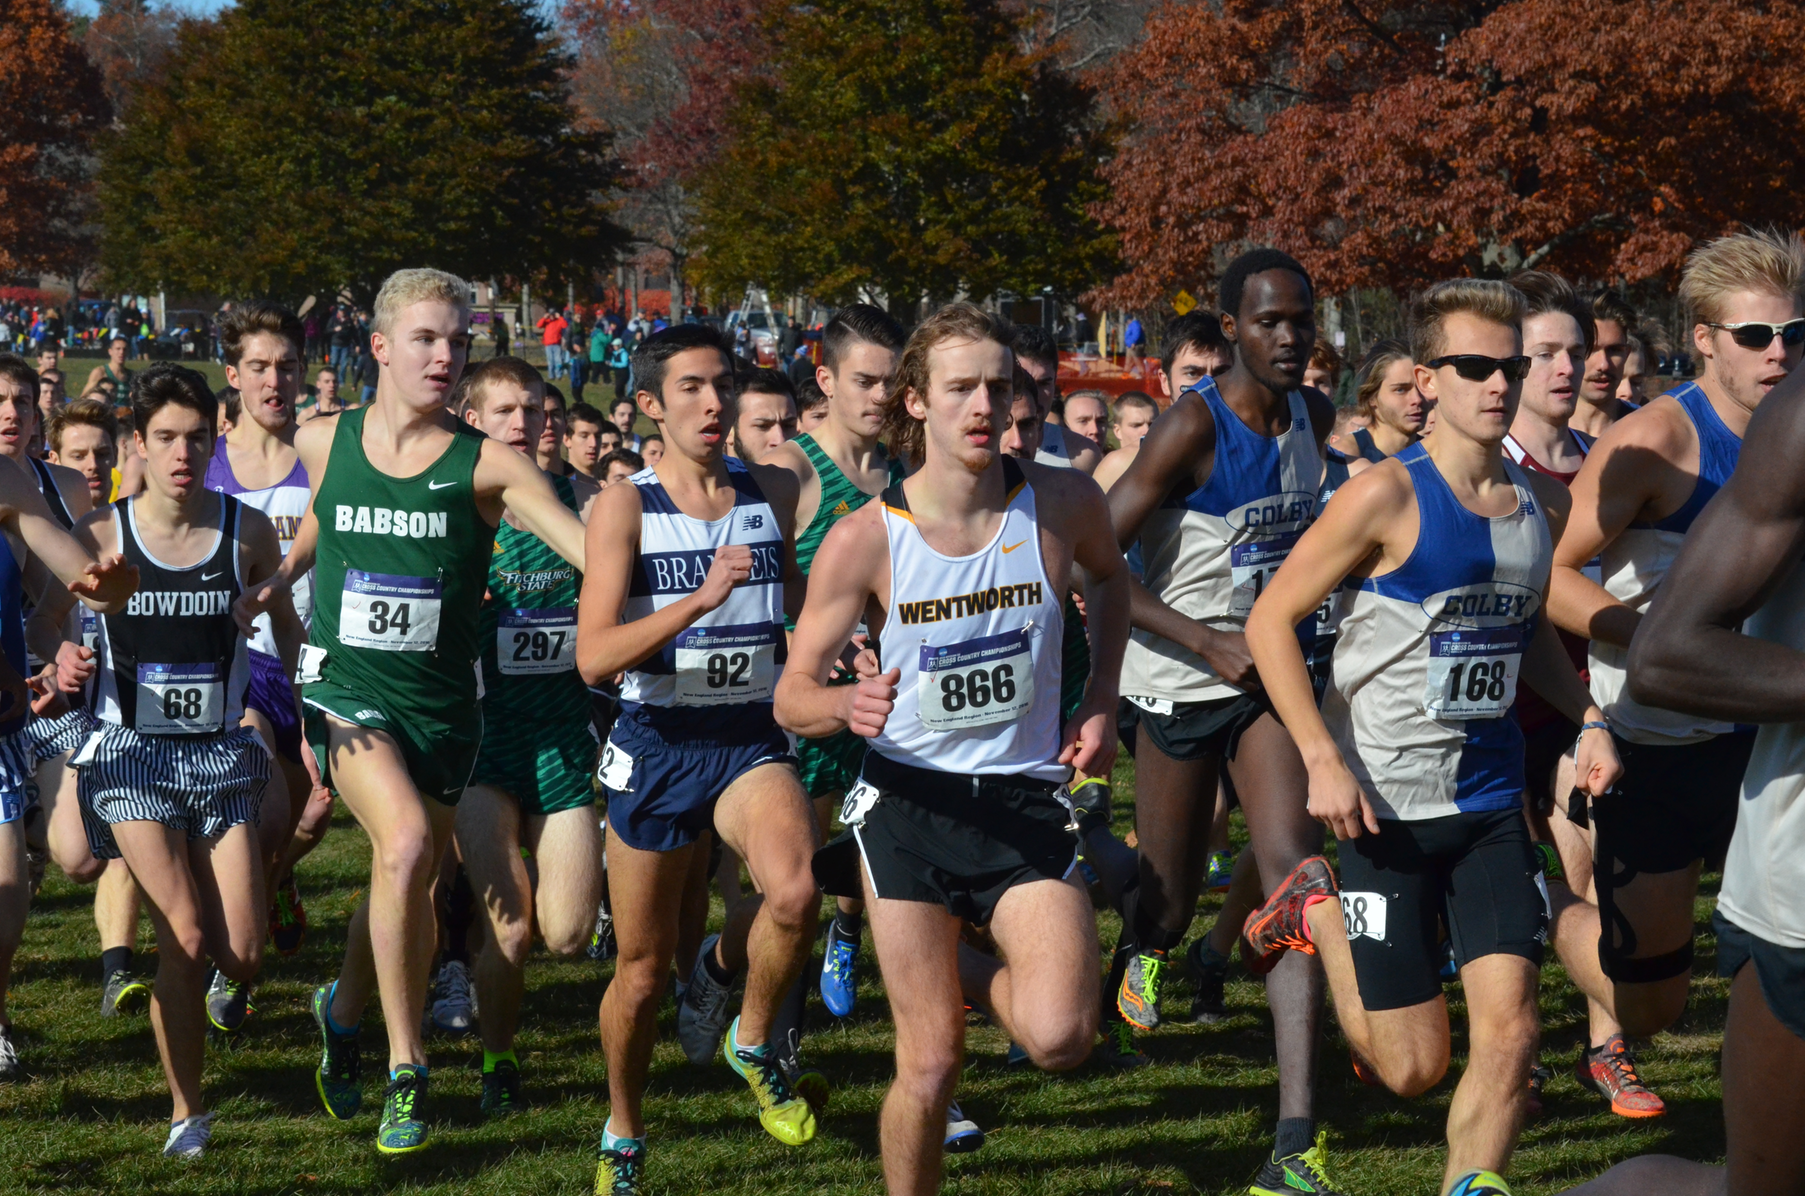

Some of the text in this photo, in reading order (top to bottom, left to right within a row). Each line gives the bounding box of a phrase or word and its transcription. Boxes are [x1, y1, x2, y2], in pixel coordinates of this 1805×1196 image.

[335, 504, 448, 539] BABSON
[1245, 499, 1314, 528] COLBY
[498, 568, 572, 585] FITCHBURG
[652, 546, 780, 591] BRAEIS
[361, 582, 435, 595] CROSS COUNTRY CHAMPIONSHIPS
[517, 580, 554, 592] STATE
[127, 590, 231, 616] BOWDOIN
[368, 600, 411, 636] 34
[898, 581, 1043, 625] WENTWORTH
[1441, 593, 1533, 617] COLBY
[512, 631, 567, 662] 297
[713, 636, 734, 644] COUNTRY
[938, 641, 1022, 665] CROSS COUNTRY CHAMPIONSHIPS
[707, 651, 750, 688] 92
[1449, 660, 1506, 702] 168
[940, 663, 1016, 712] 866
[163, 688, 202, 720] 68
[984, 708, 1010, 716] November
[599, 745, 615, 780] 2
